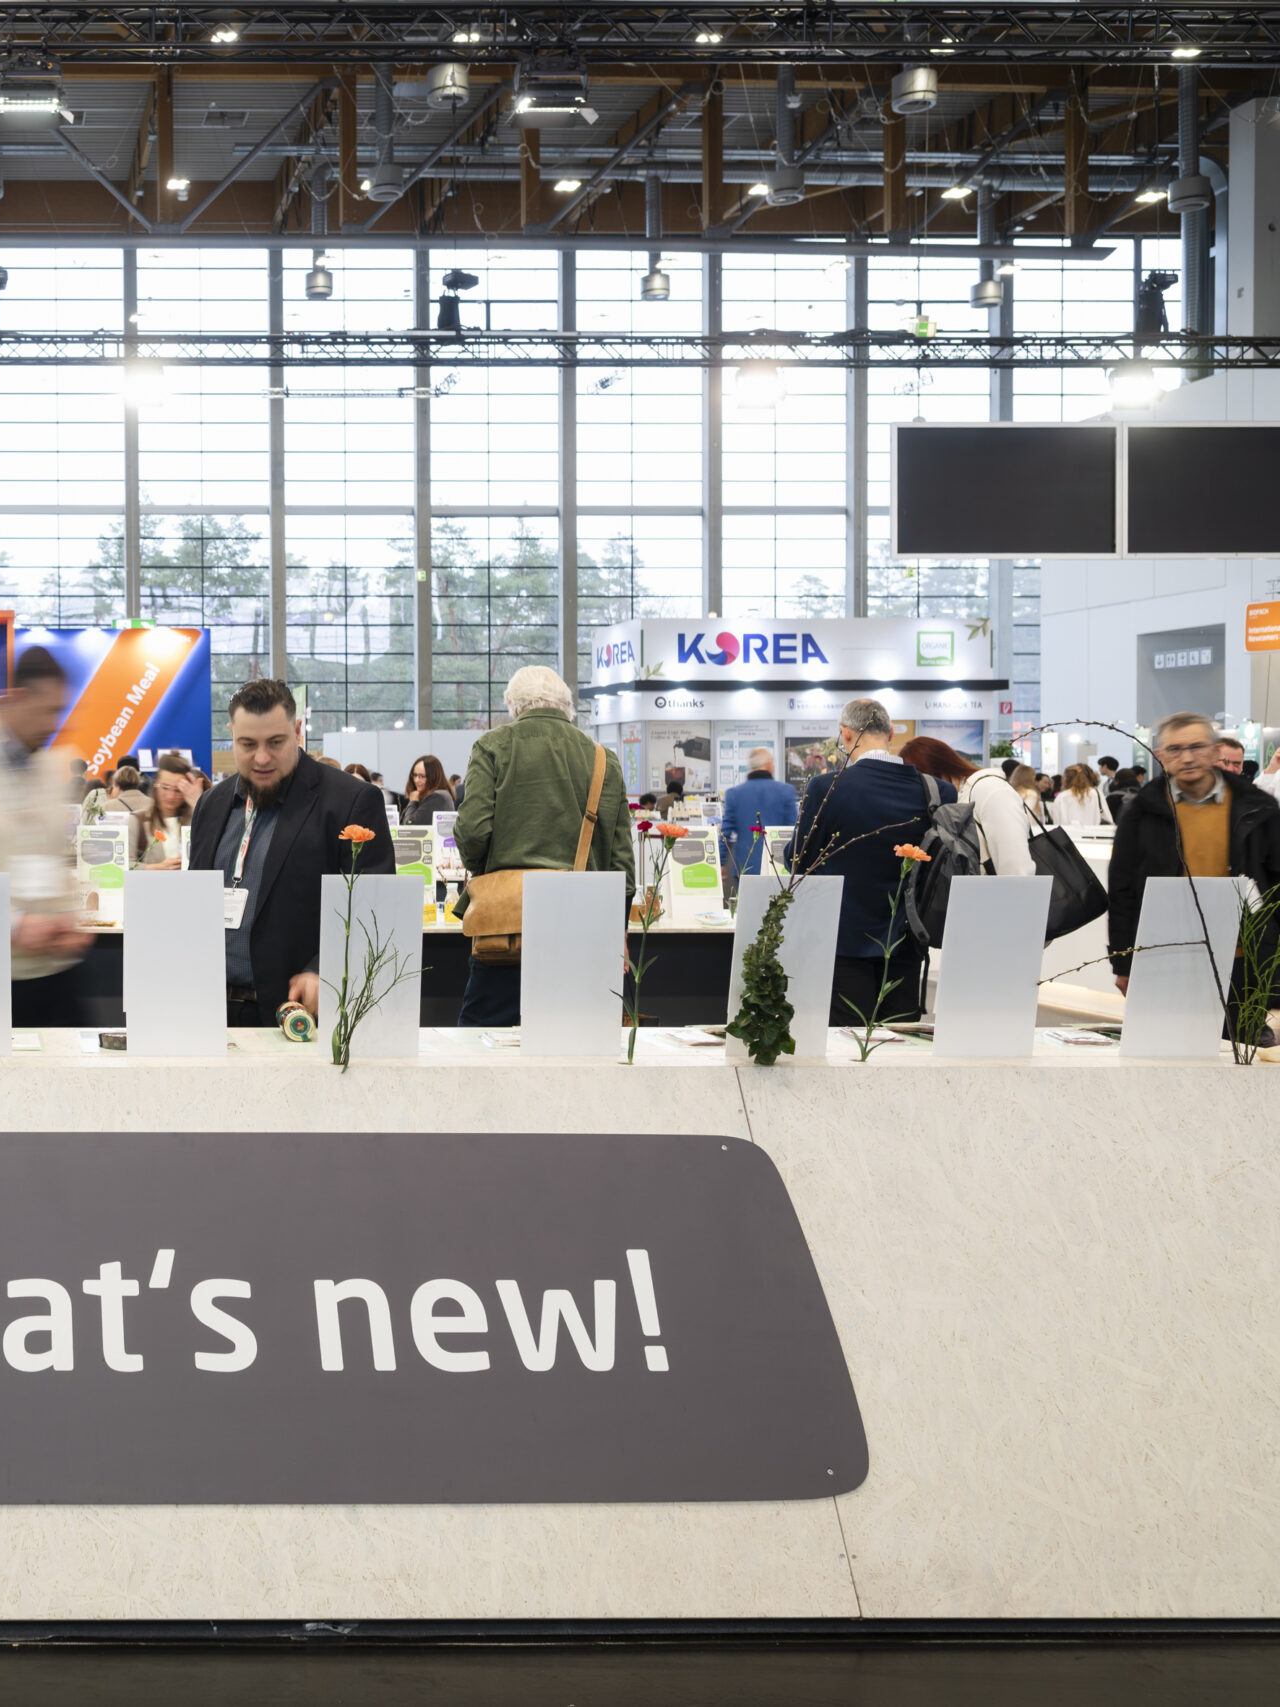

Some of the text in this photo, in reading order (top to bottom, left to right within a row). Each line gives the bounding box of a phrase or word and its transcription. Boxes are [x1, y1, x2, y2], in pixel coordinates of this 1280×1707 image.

[596, 639, 635, 669] KOREA
[677, 631, 829, 666] KOREA
[86, 661, 161, 776] Soybean Meal
[312, 1248, 671, 1374] new!
